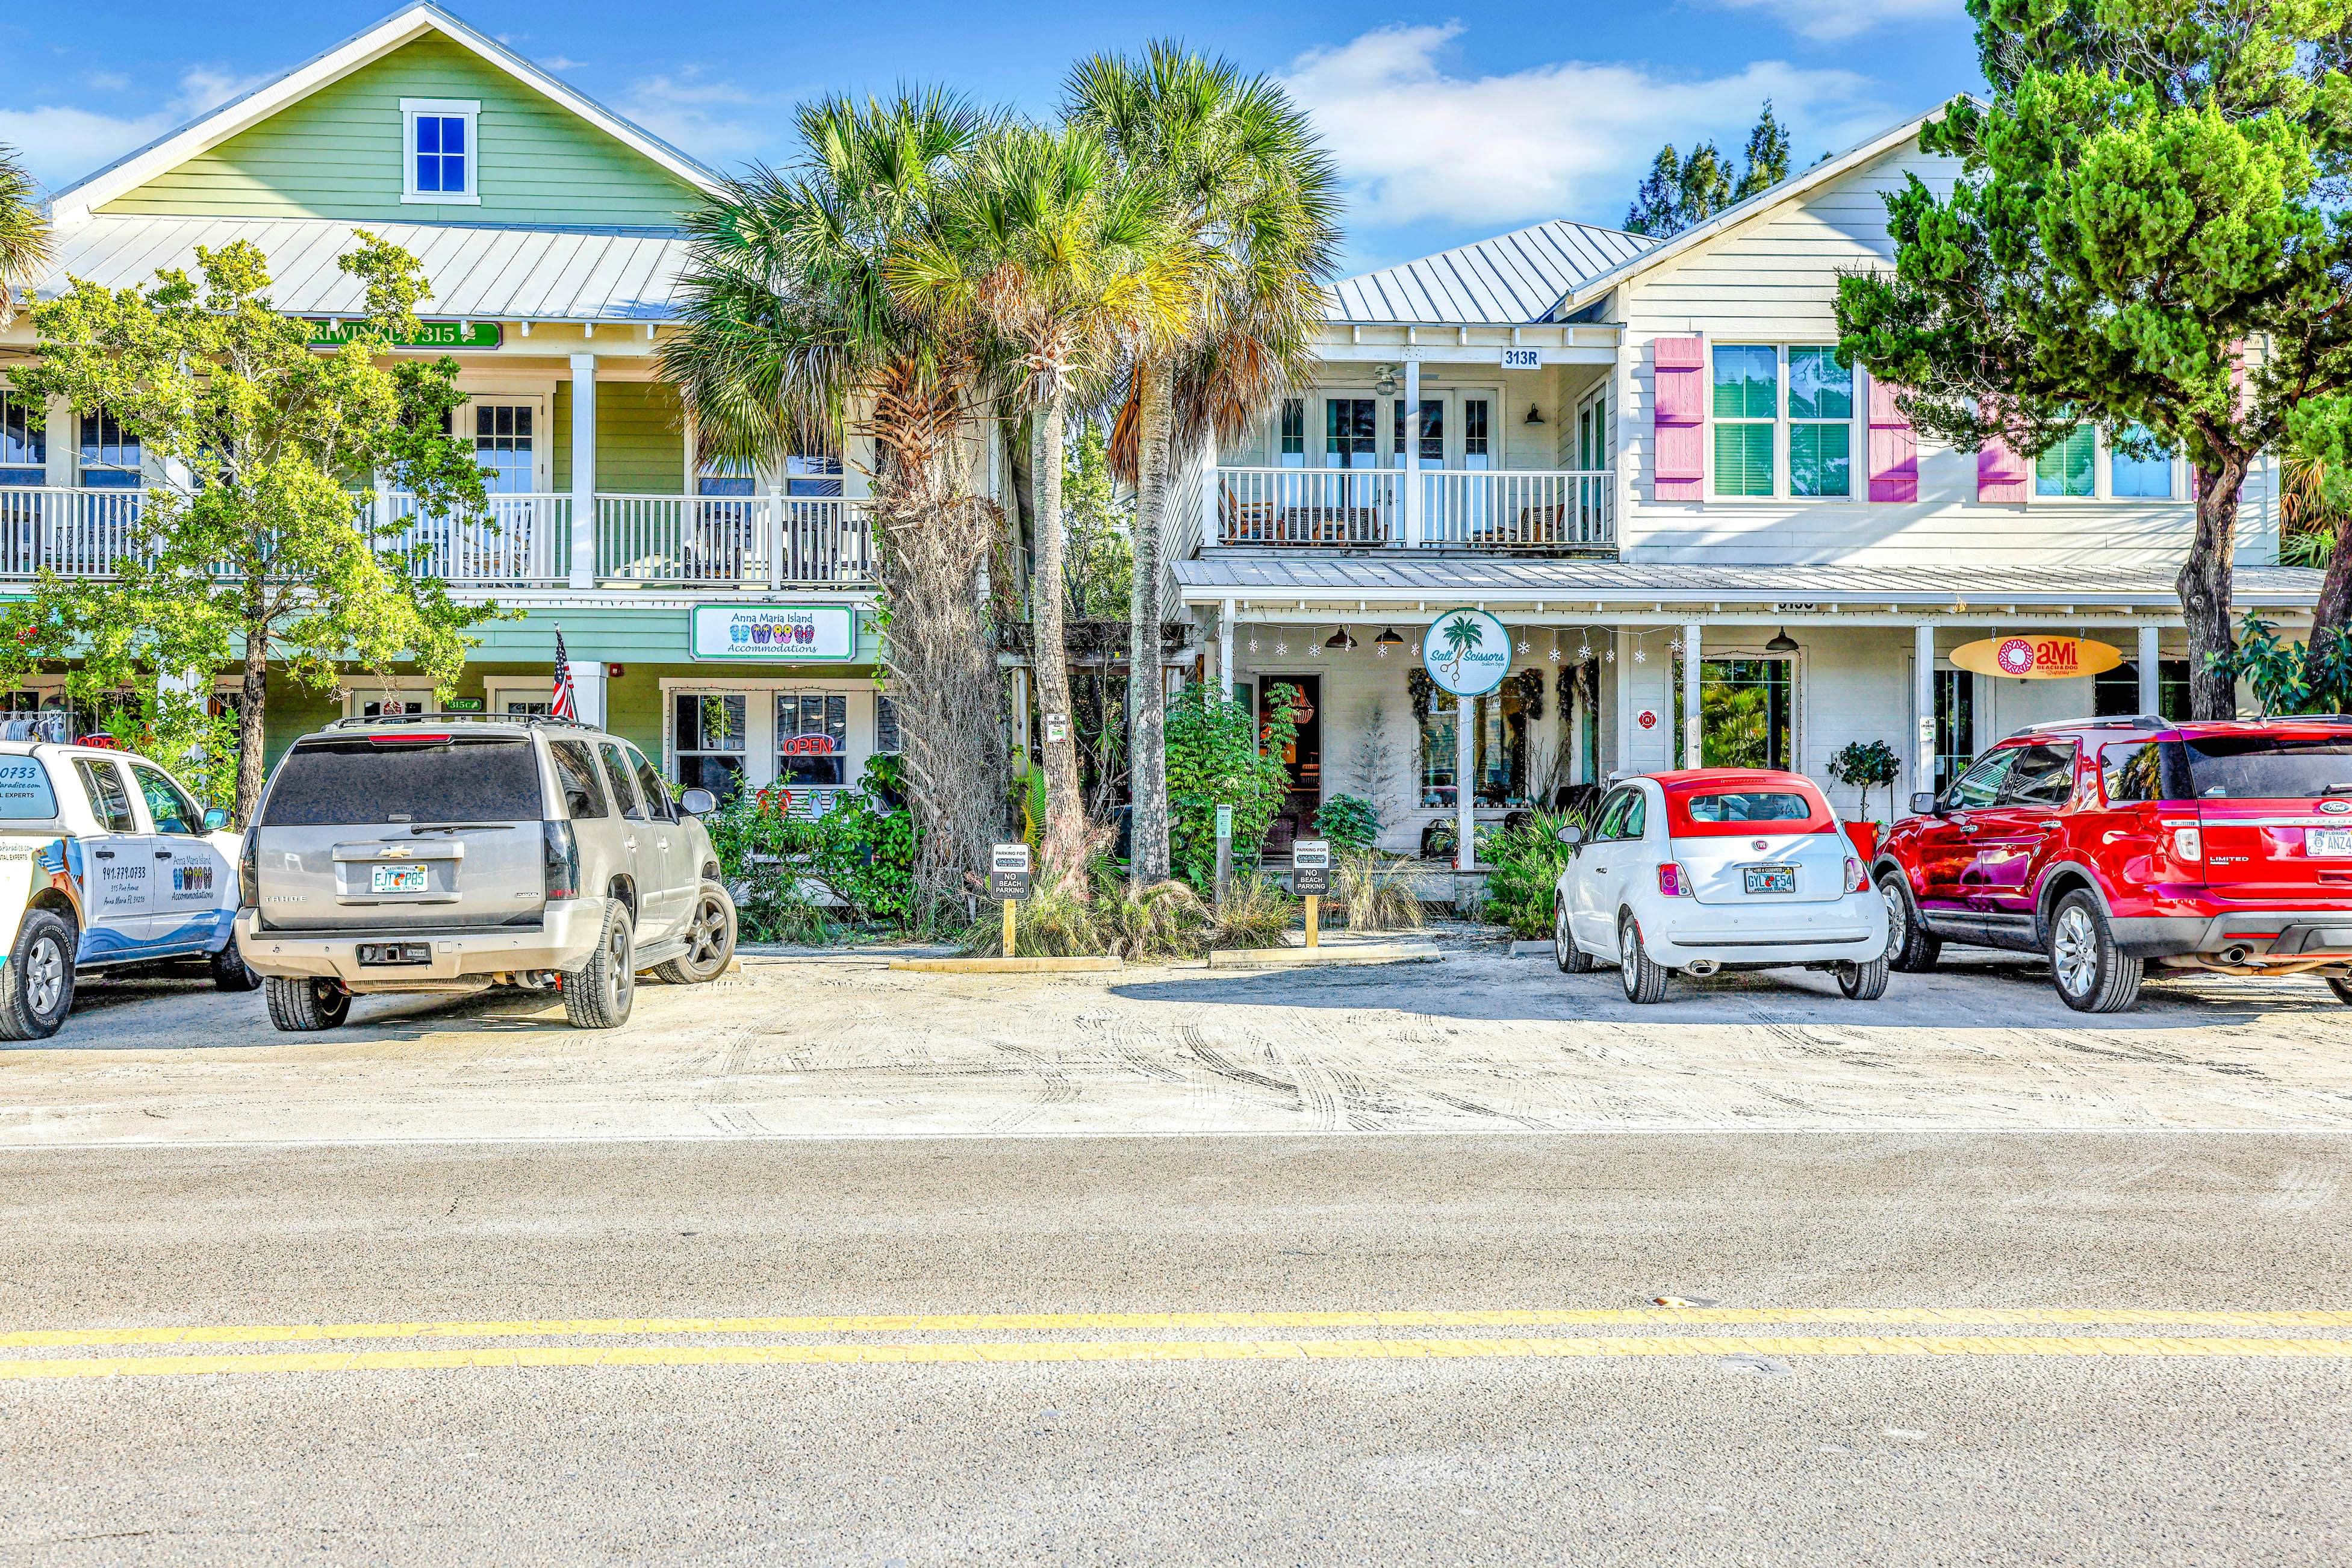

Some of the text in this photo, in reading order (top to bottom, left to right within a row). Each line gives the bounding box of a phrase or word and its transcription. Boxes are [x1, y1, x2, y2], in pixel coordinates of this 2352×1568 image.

[422, 327, 454, 342] 315
[1505, 350, 1537, 365] 313R
[732, 612, 812, 623] Anna Maria Island
[727, 644, 818, 653] Accommodations
[1430, 650, 1505, 661] Salt Scissors
[784, 738, 832, 756] OPEN
[2328, 803, 2346, 812] Ford
[173, 853, 212, 865] Anna Maria Island
[102, 866, 146, 880] 941.779.0733
[375, 872, 424, 886] EJT P85
[1748, 875, 1792, 887] GYL F54
[104, 897, 114, 906] Anna
[115, 896, 126, 904] Maria
[128, 895, 133, 904] FL
[172, 889, 214, 901] Accommodations
[39, 925, 73, 963] DESTINATION
